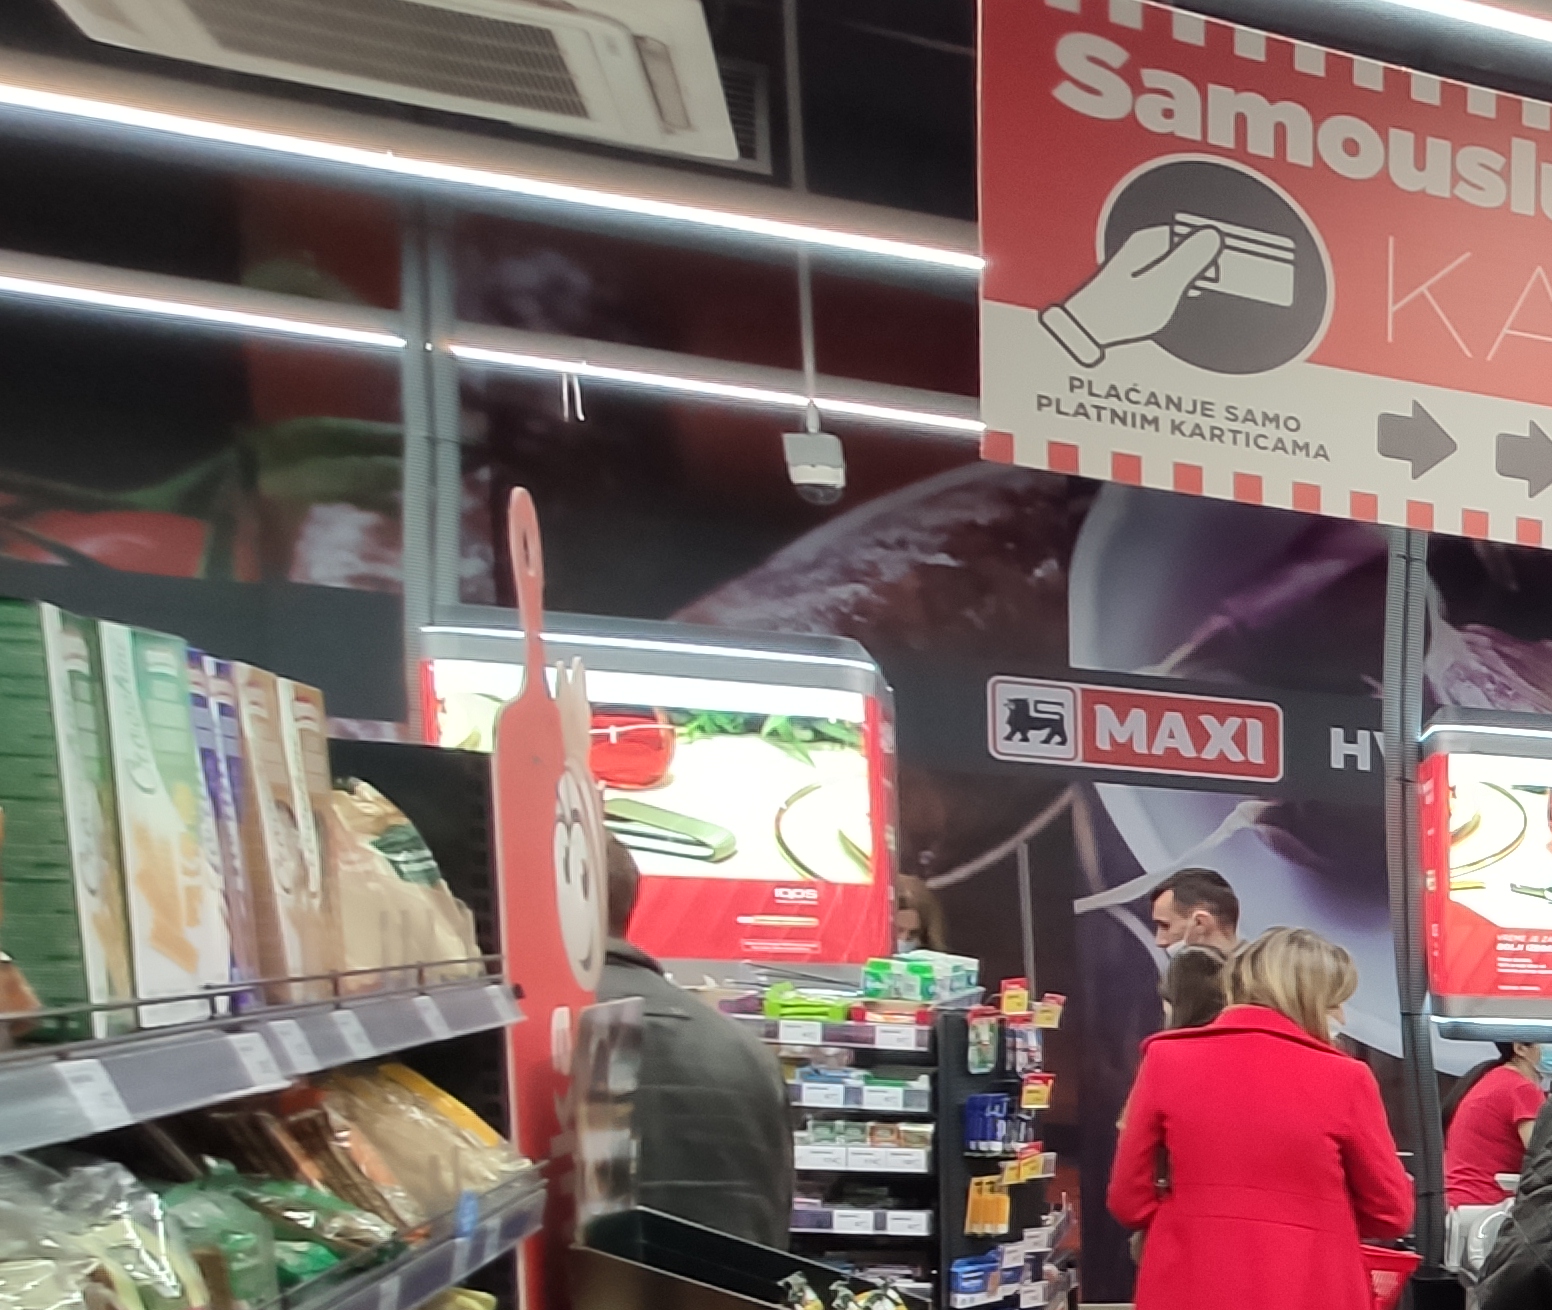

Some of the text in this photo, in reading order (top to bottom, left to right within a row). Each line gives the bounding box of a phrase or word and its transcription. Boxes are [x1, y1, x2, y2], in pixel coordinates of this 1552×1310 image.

[1036, 393, 1331, 462] PLATNIM KARTICAMA
[1068, 375, 1301, 433] PLAĆANJE SAMO
[1095, 703, 1265, 766] MAXI
